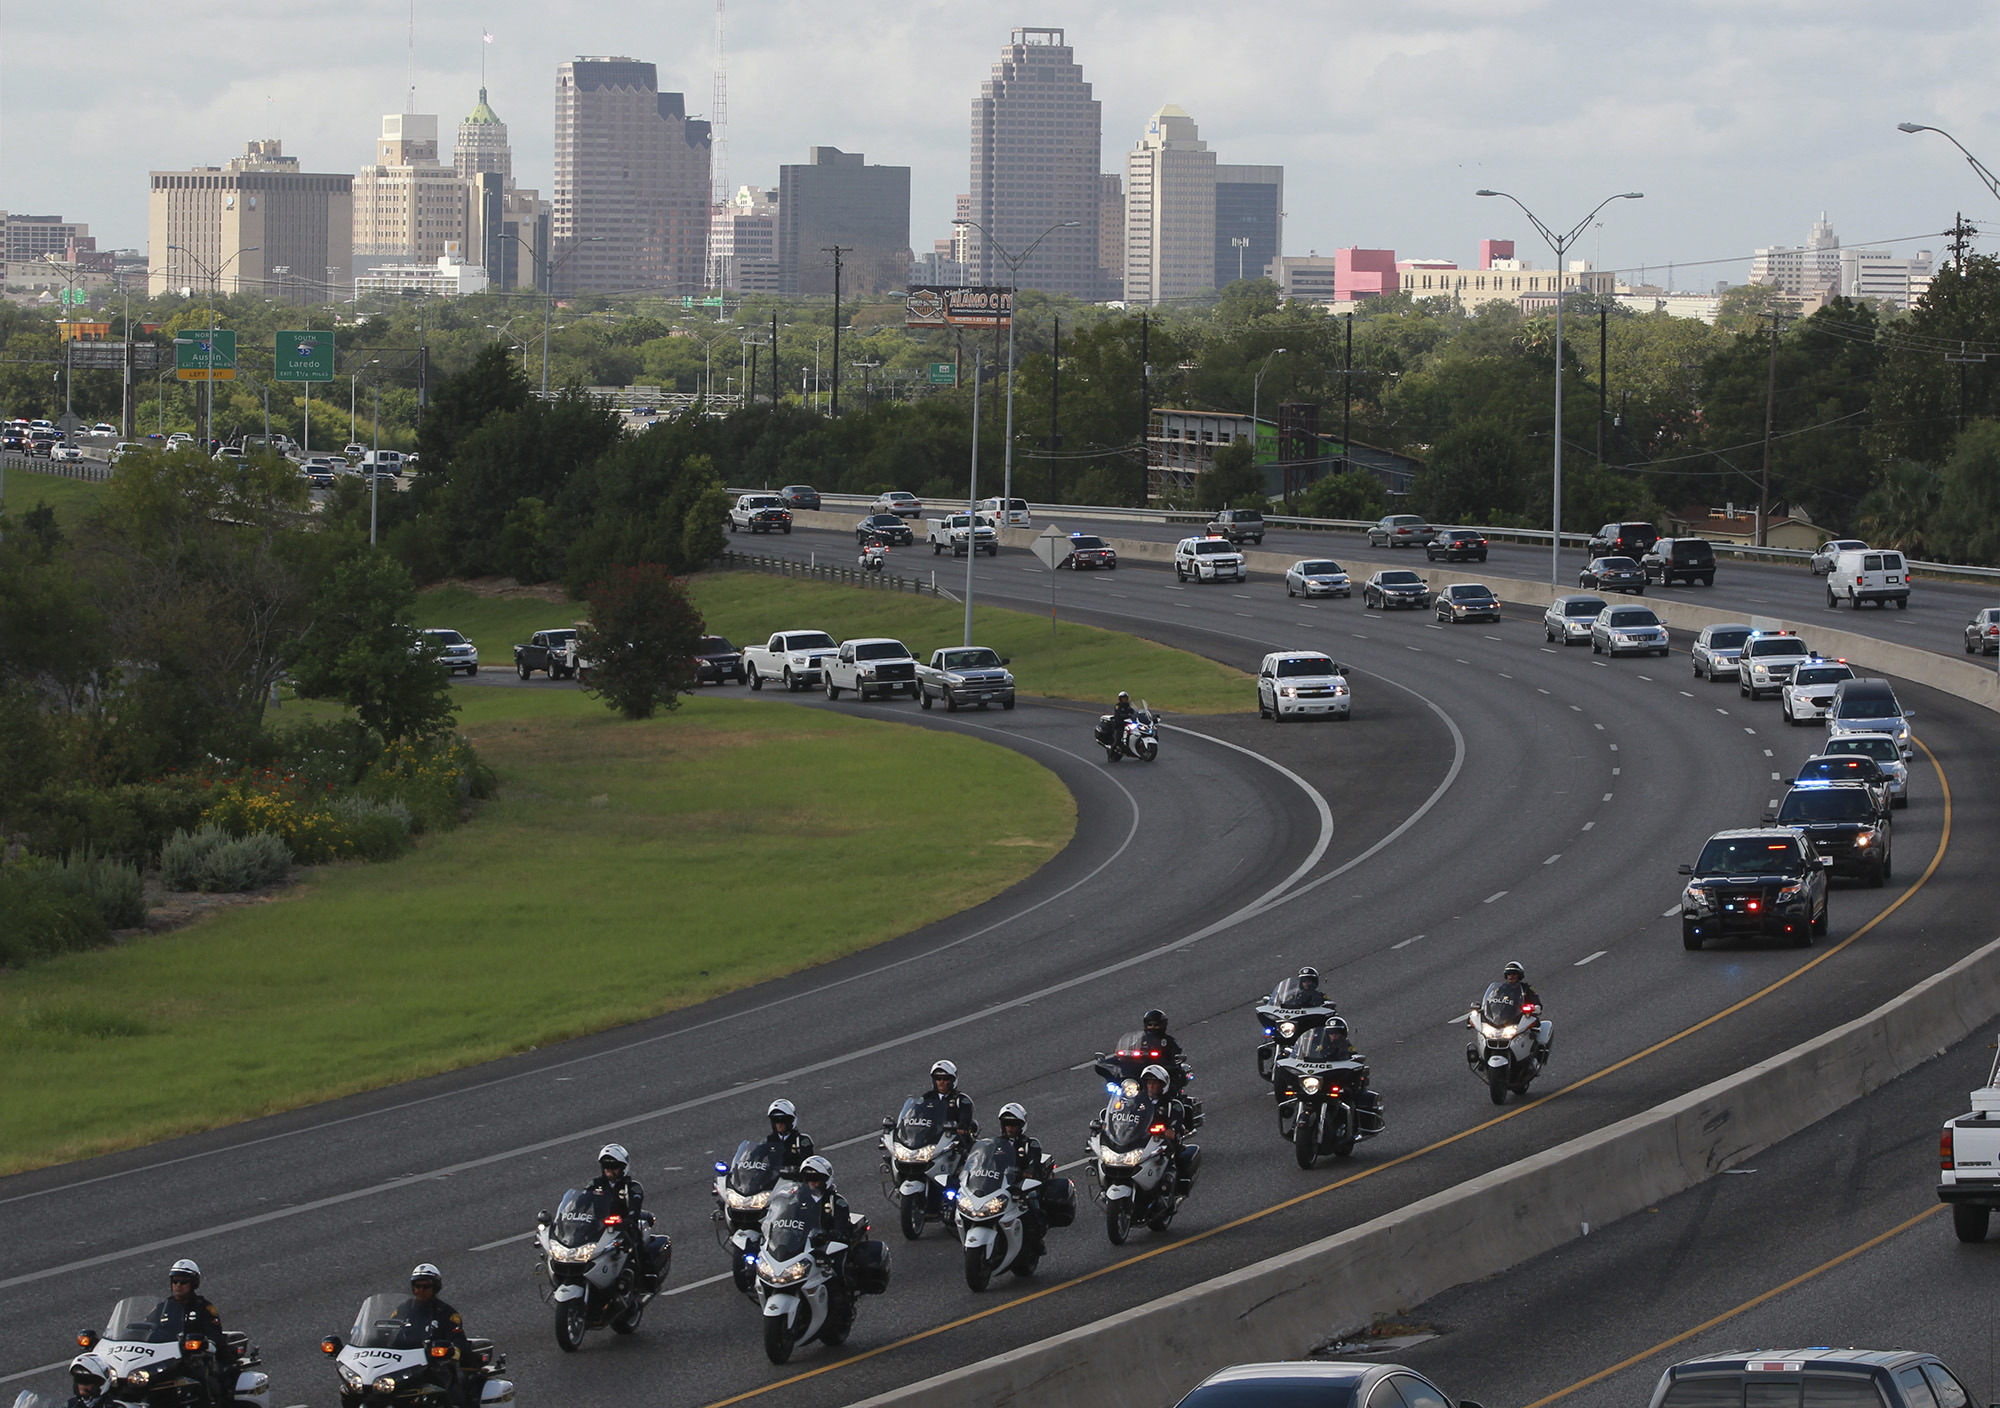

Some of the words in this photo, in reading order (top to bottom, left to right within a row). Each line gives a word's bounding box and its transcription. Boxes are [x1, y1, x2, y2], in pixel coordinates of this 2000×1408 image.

[949, 293, 988, 308] ALAMO
[990, 293, 1013, 308] CTY
[192, 353, 222, 361] Ausin
[288, 360, 320, 368] Laredo
[903, 1118, 932, 1127] POLICE
[1111, 1113, 1140, 1124] POLICE
[737, 1161, 768, 1171] POLICE
[970, 1169, 1000, 1179] POLICE
[561, 1212, 594, 1223] POLICE
[772, 1219, 805, 1230] POLICE
